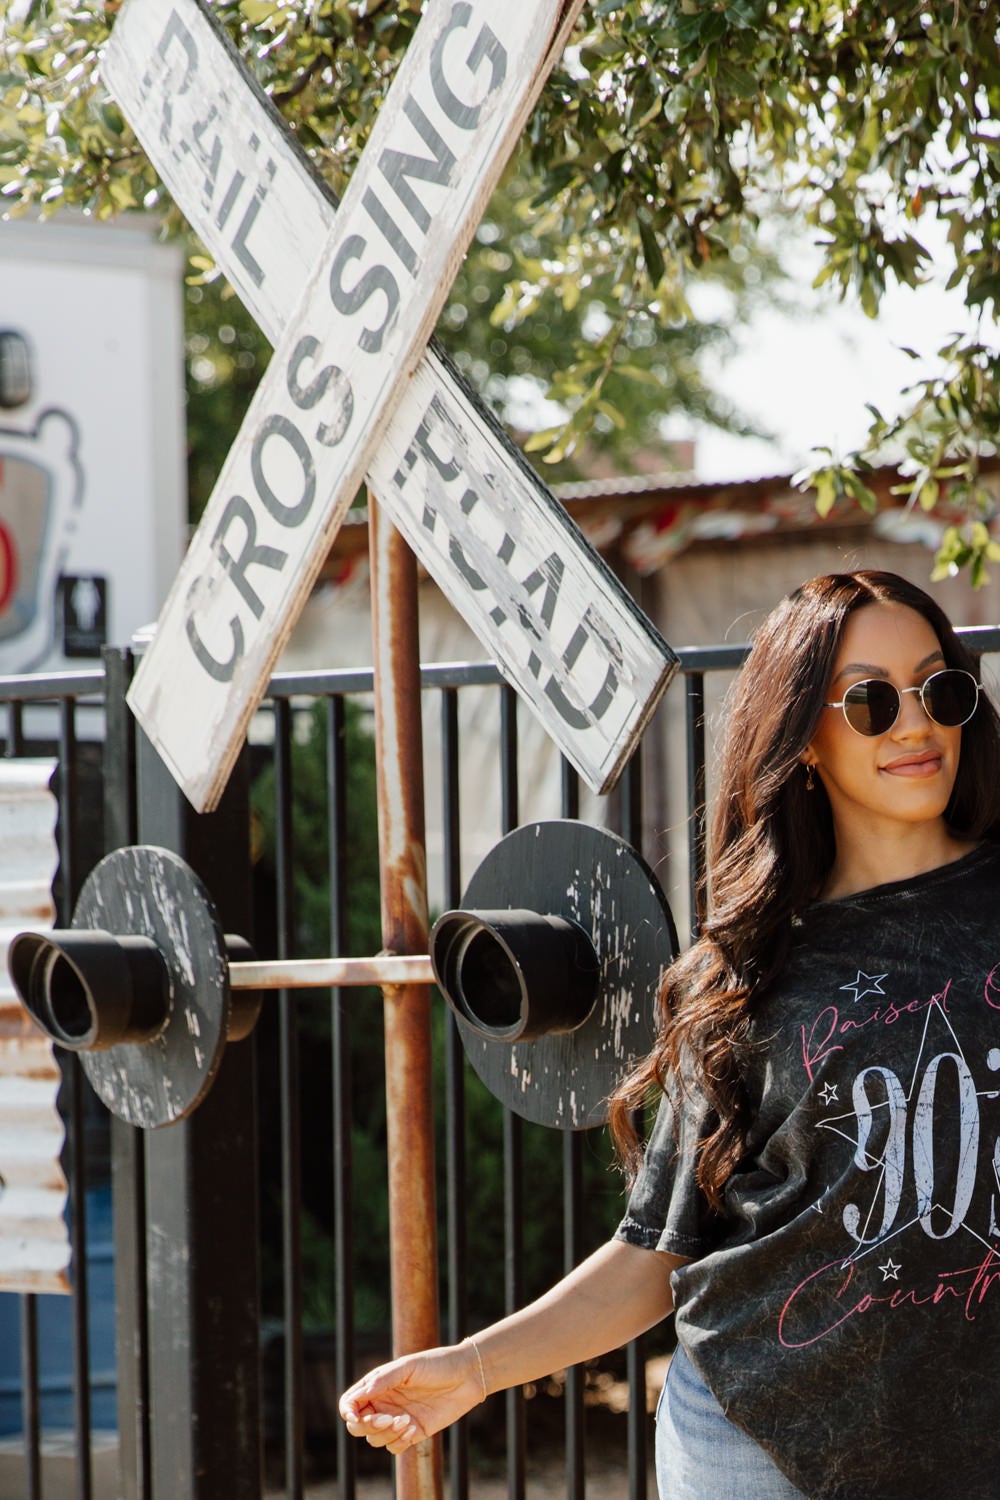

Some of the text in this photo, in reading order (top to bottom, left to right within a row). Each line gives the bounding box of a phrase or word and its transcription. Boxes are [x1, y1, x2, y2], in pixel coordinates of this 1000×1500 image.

[139, 8, 624, 730] RAIL ROAD
[801, 977, 952, 1082] Raised
